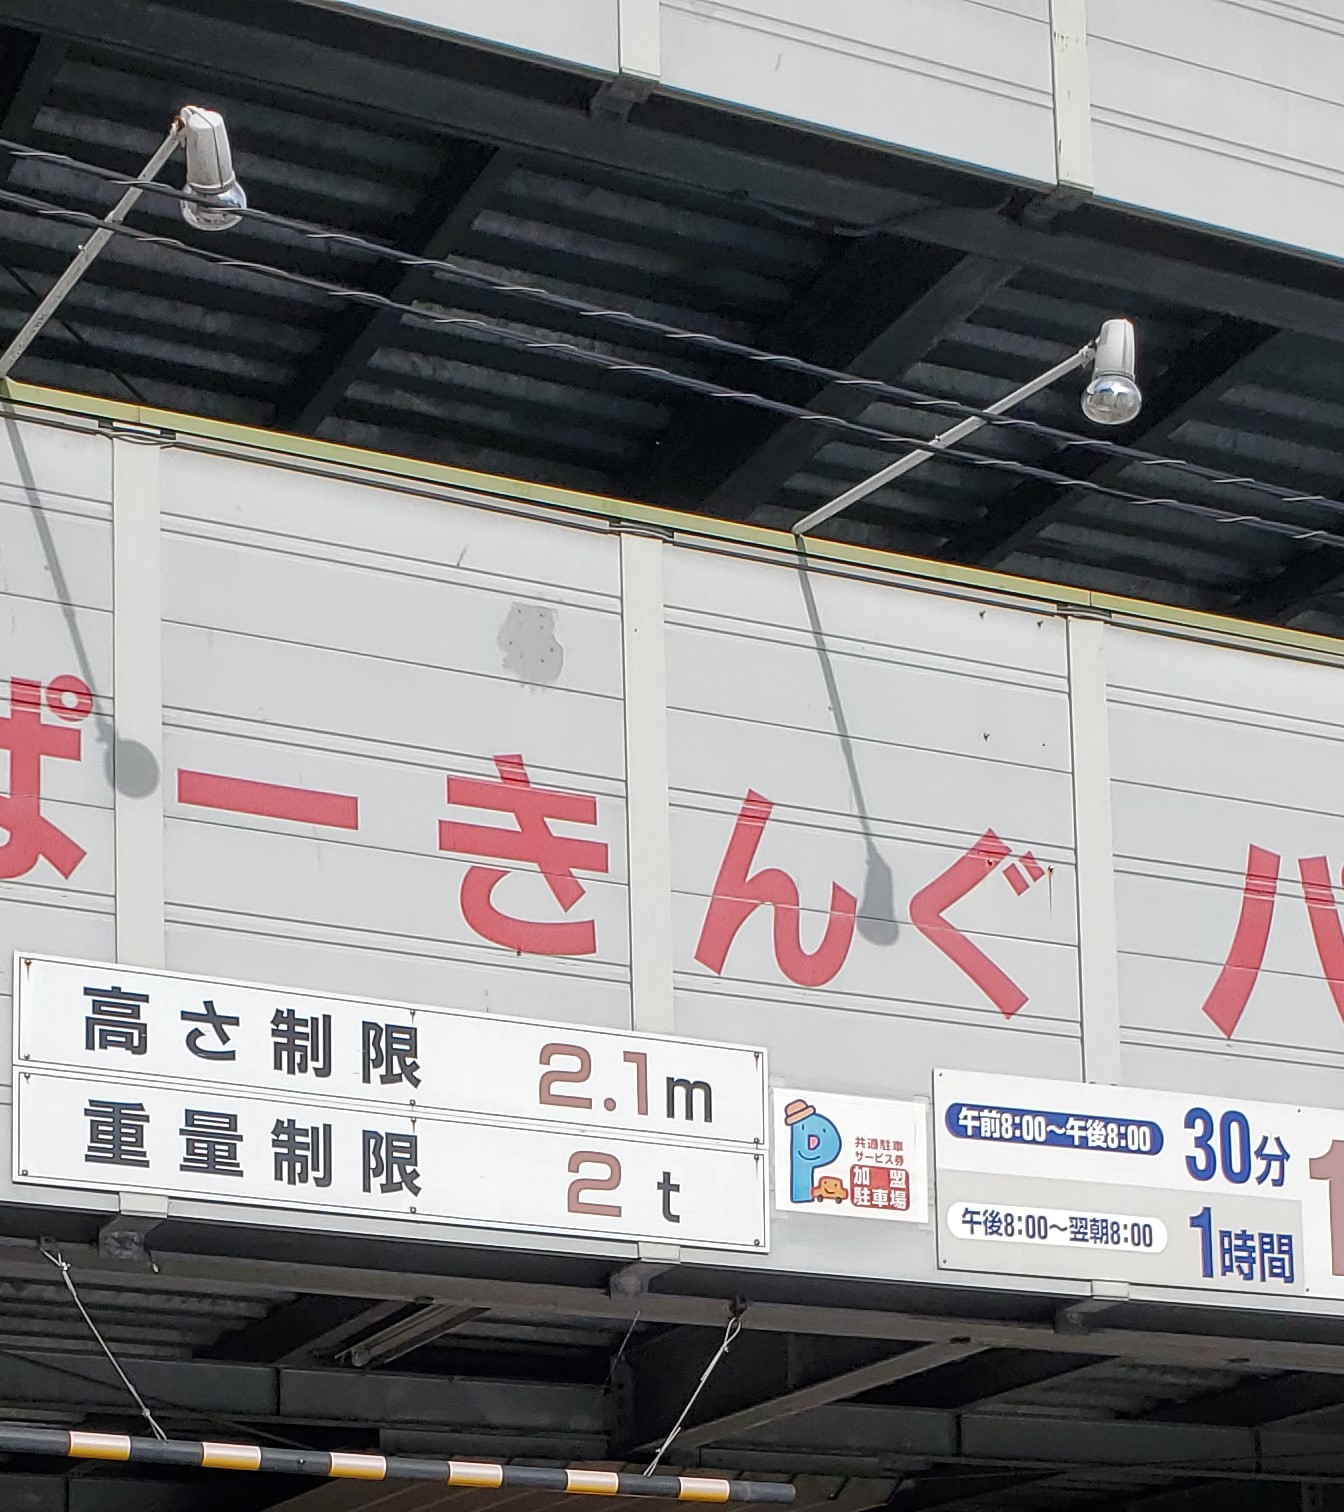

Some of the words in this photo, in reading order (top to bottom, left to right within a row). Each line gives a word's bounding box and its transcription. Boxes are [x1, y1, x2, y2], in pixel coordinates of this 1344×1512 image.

[83, 986, 422, 1089] 高さ制限
[538, 1042, 713, 1124] 2.1m
[83, 1099, 422, 1197] 重量制限
[567, 1151, 622, 1218] 2
[655, 1169, 681, 1225] t
[1184, 1107, 1291, 1188] 30分
[853, 1186, 907, 1210] 駐車場
[1189, 1206, 1296, 1284] 1時間
